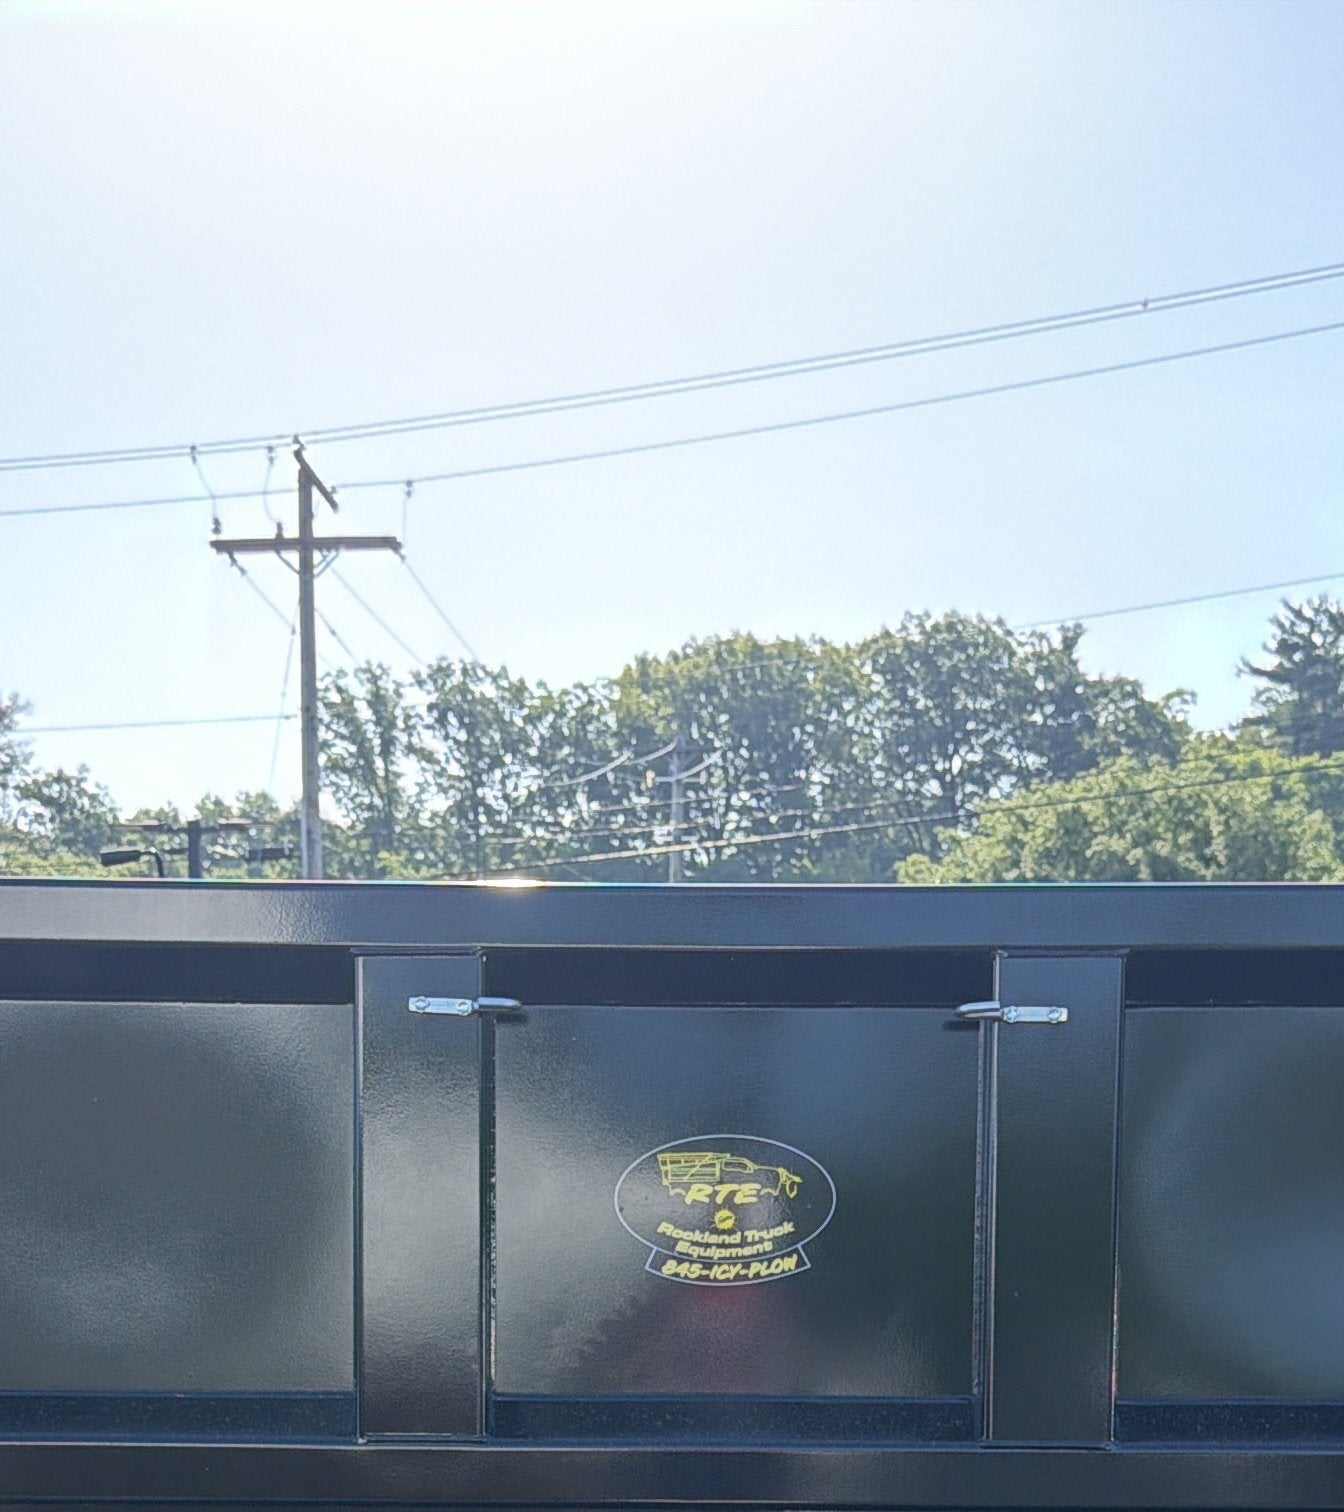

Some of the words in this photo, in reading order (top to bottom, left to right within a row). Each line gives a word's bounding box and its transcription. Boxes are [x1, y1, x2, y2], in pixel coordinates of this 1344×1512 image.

[685, 1183, 761, 1204] RTE
[657, 1221, 742, 1244] Rockland
[743, 1221, 795, 1242] Truck
[675, 1240, 773, 1260] Equipment
[661, 1254, 798, 1280] 845-ICY-PLOW
